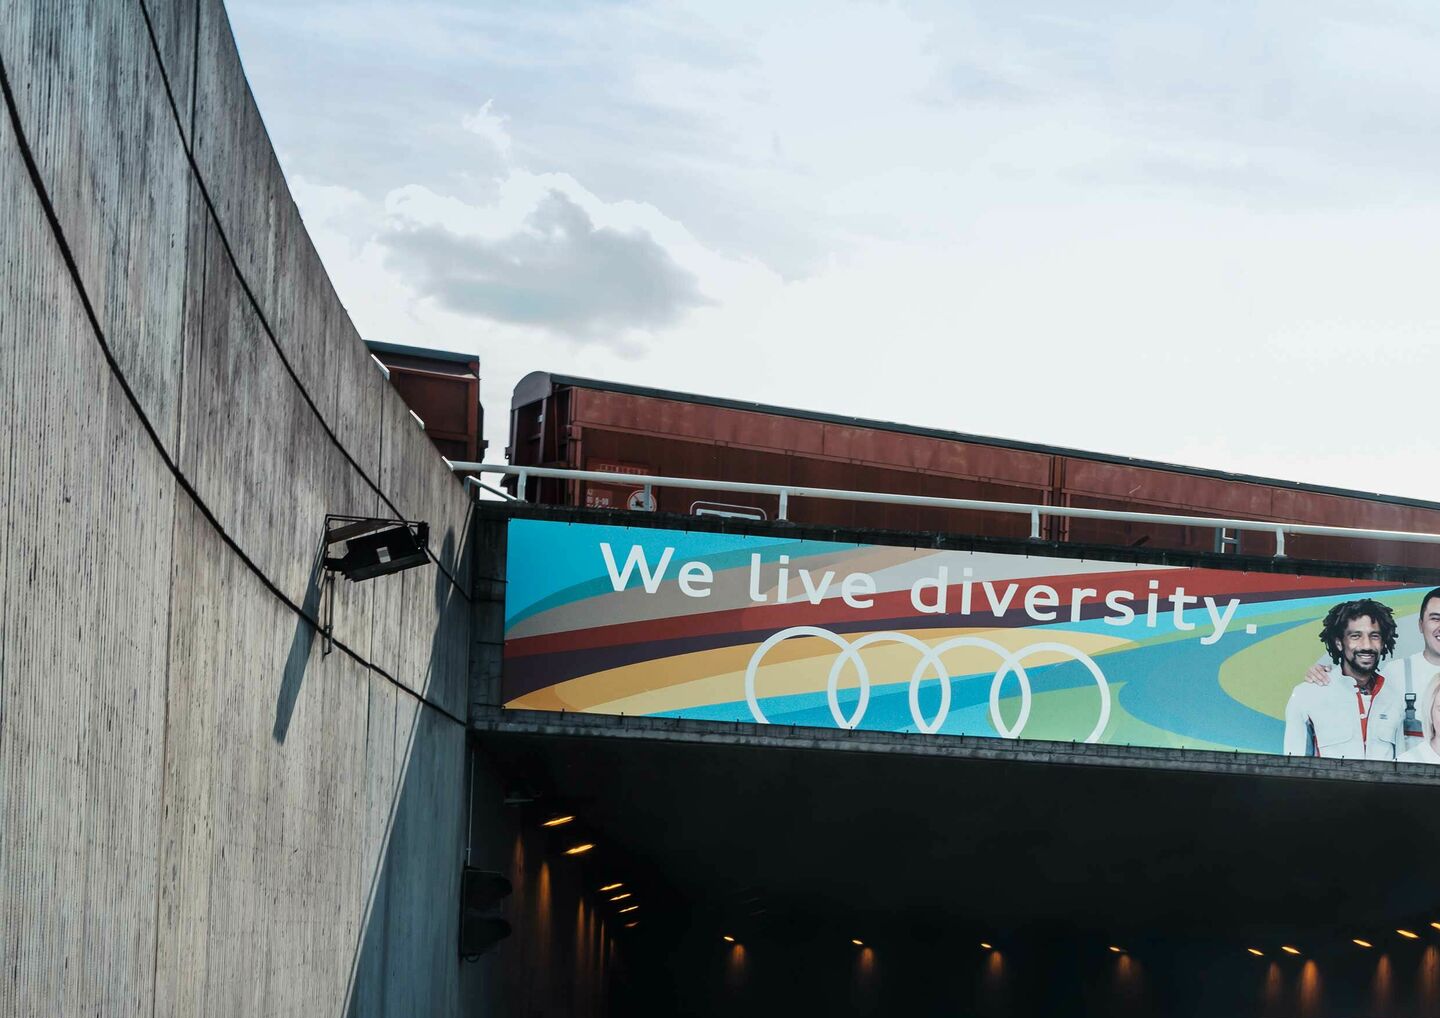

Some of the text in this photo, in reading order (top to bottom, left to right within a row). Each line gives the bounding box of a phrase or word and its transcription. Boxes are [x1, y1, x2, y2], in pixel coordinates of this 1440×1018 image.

[600, 542, 1258, 646] We live diversity.
